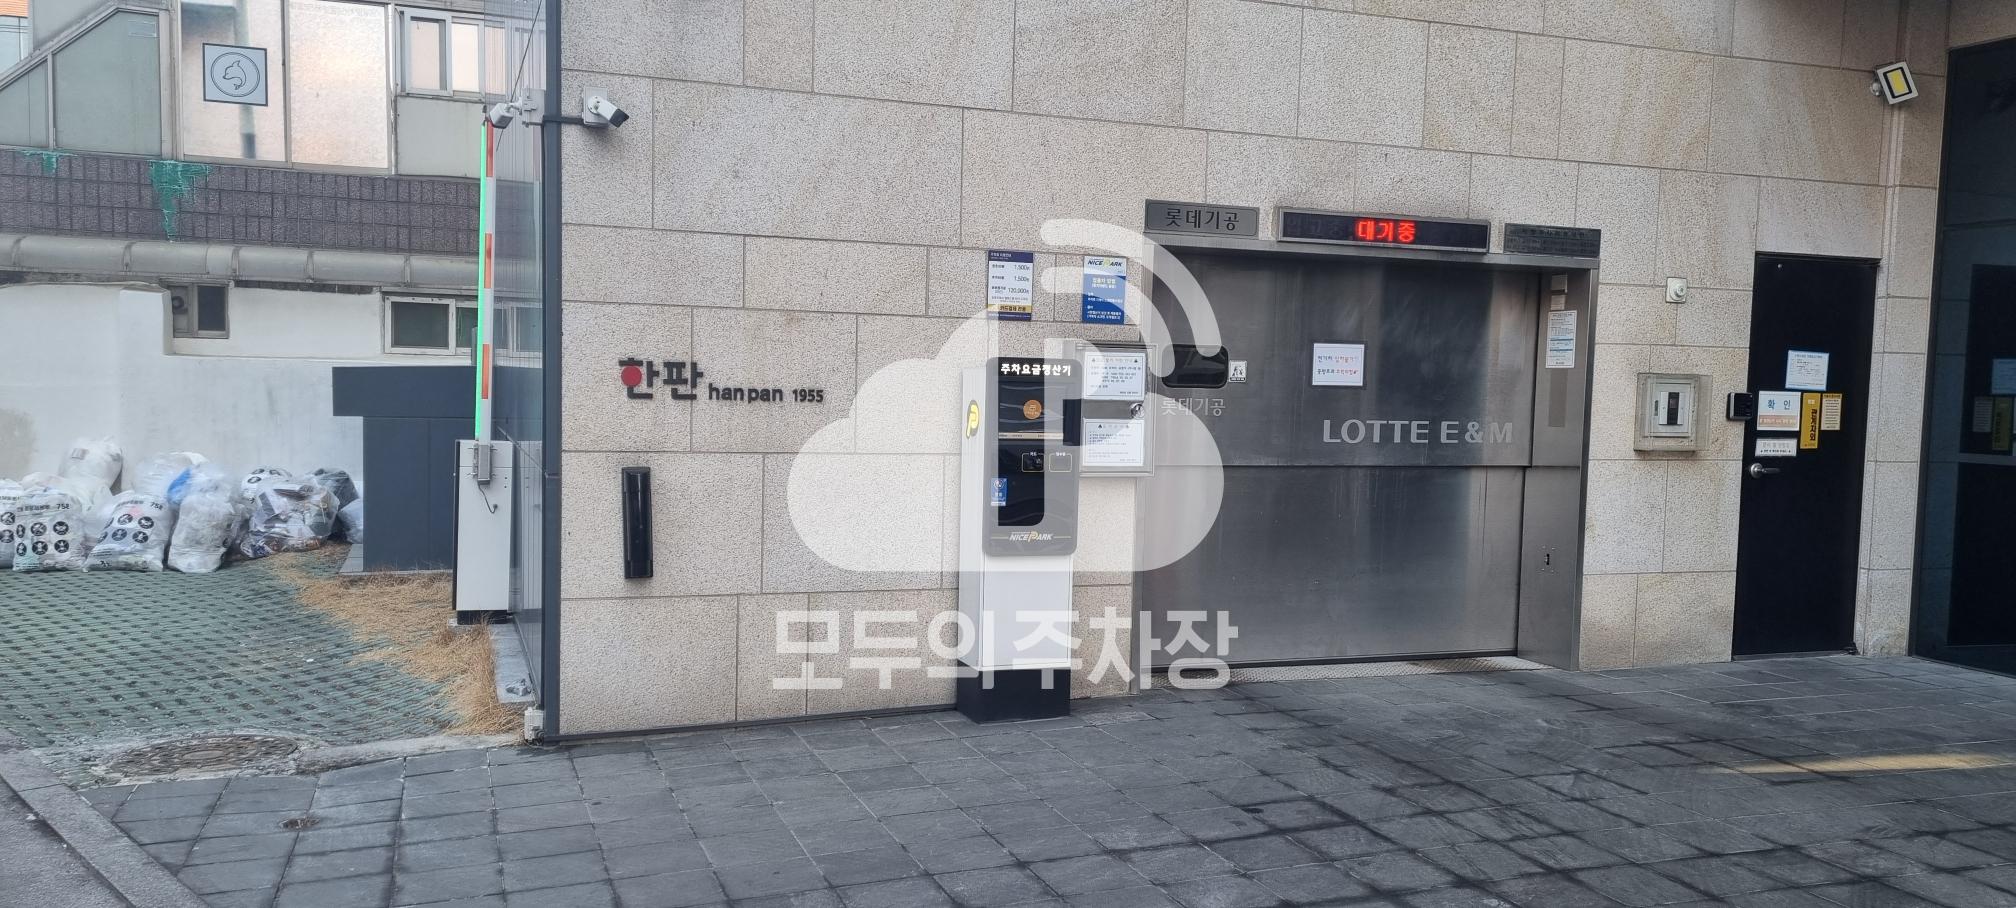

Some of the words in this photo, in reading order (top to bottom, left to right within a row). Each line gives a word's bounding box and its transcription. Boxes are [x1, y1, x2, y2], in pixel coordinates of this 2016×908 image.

[1166, 207, 1240, 232] 롯데기공
[1357, 218, 1416, 243] 대기중
[618, 357, 704, 400] 한판
[792, 387, 824, 403] 1955
[1000, 363, 1072, 377] 주차요금정산기
[1161, 397, 1226, 417] 롯데기공
[1323, 418, 1429, 444] LOTTE
